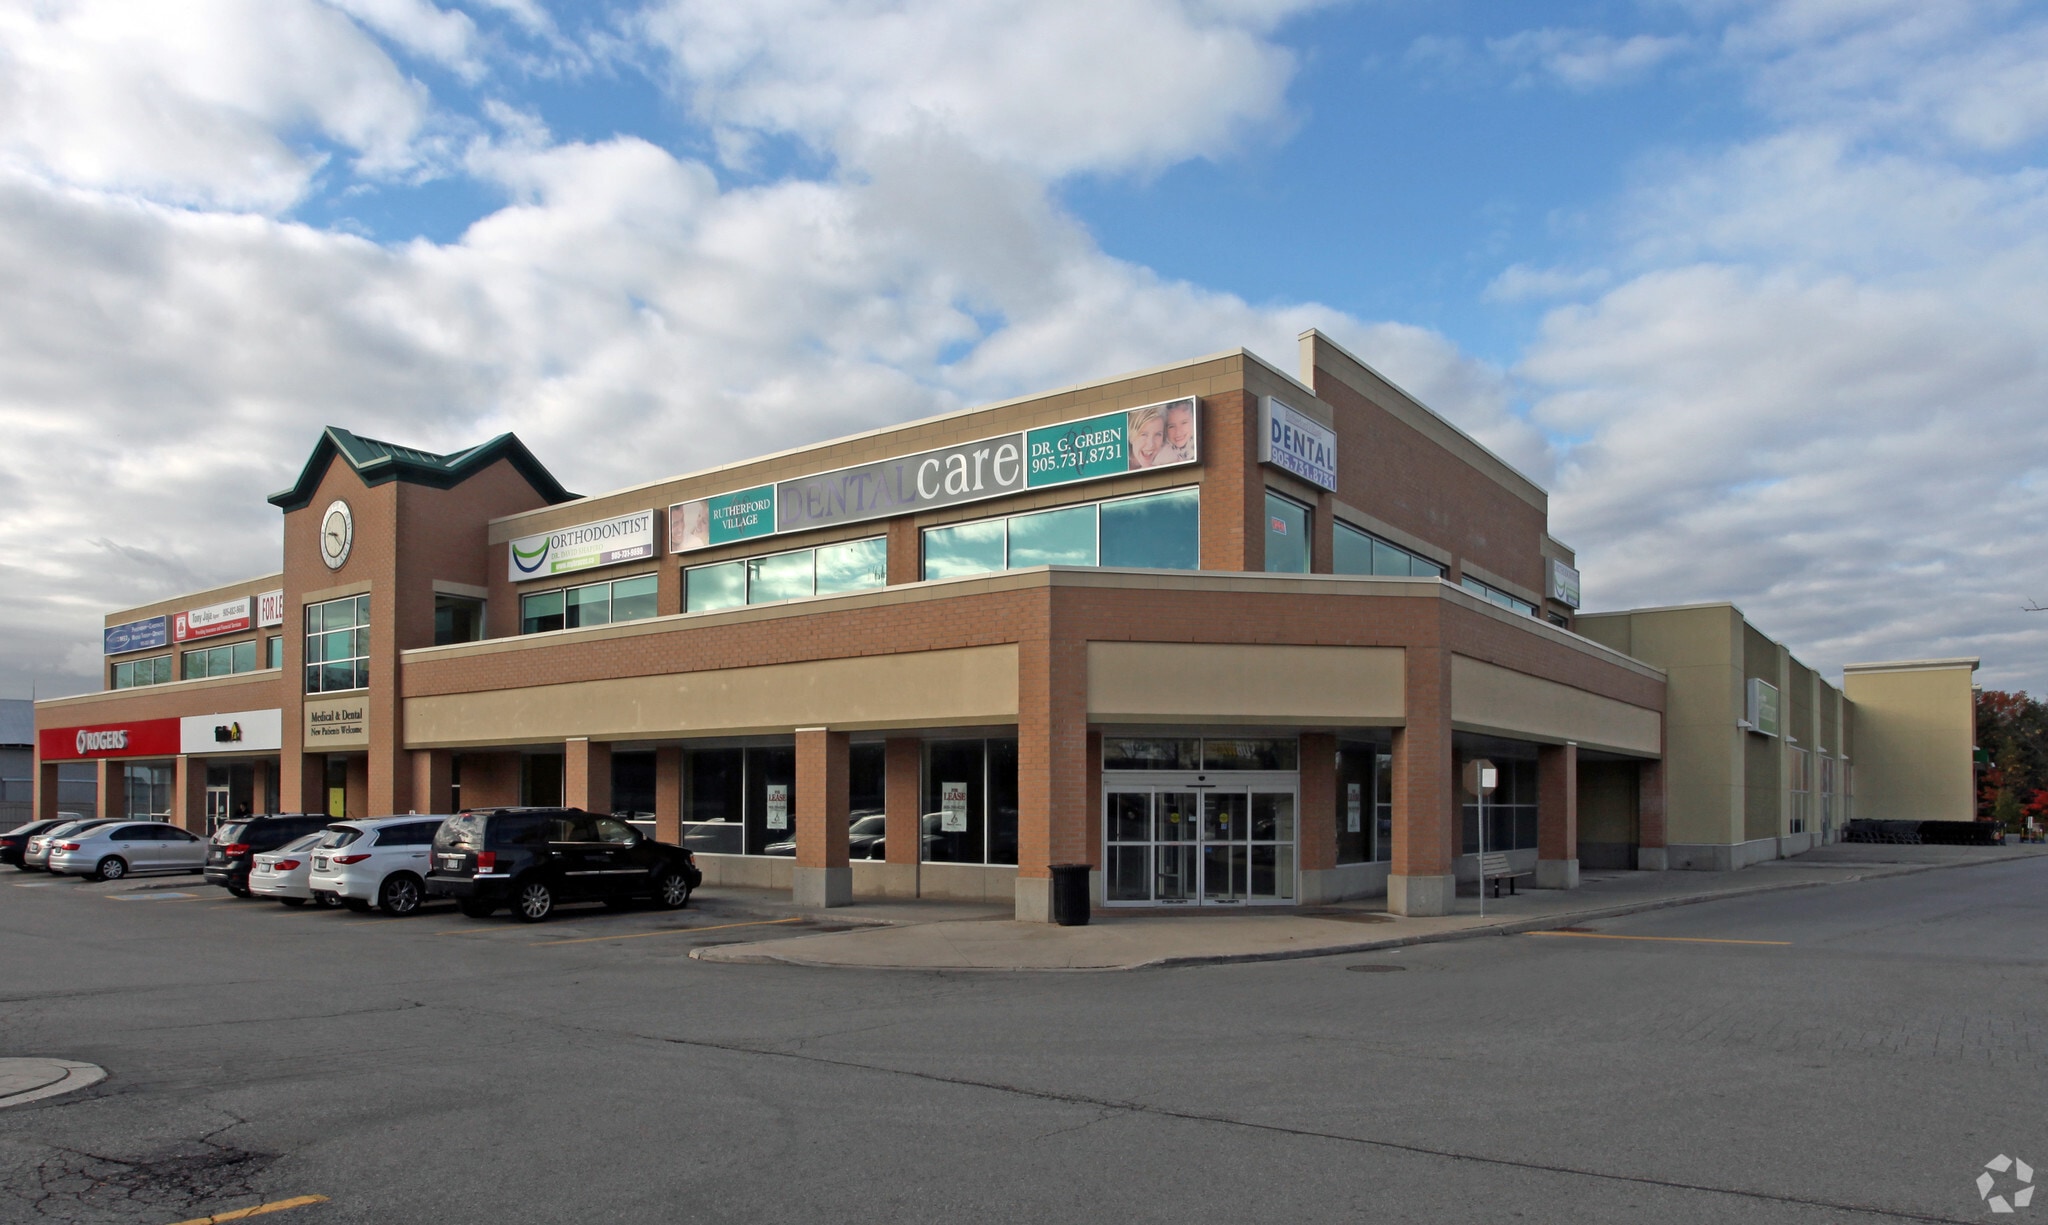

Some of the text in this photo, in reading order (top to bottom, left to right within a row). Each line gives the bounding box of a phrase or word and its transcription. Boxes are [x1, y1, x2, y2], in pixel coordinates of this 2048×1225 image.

[1032, 427, 1122, 457] DR. G. GREEN
[1272, 417, 1334, 471] DENTAL
[1032, 443, 1122, 473] 905.731.8731
[1272, 447, 1335, 490] 905.731.8731
[917, 442, 1020, 500] care
[713, 498, 771, 520] RUTHERFORD
[551, 515, 649, 549] ORTHODONTIST
[722, 513, 758, 530] VILLAGE
[192, 613, 203, 625] Tony
[262, 596, 275, 621] FOR
[311, 710, 334, 722] Medical
[342, 707, 363, 720] Dental
[87, 730, 126, 749] ROGERS
[311, 725, 363, 736] New Patients Welcome
[944, 792, 966, 801] LEASE
